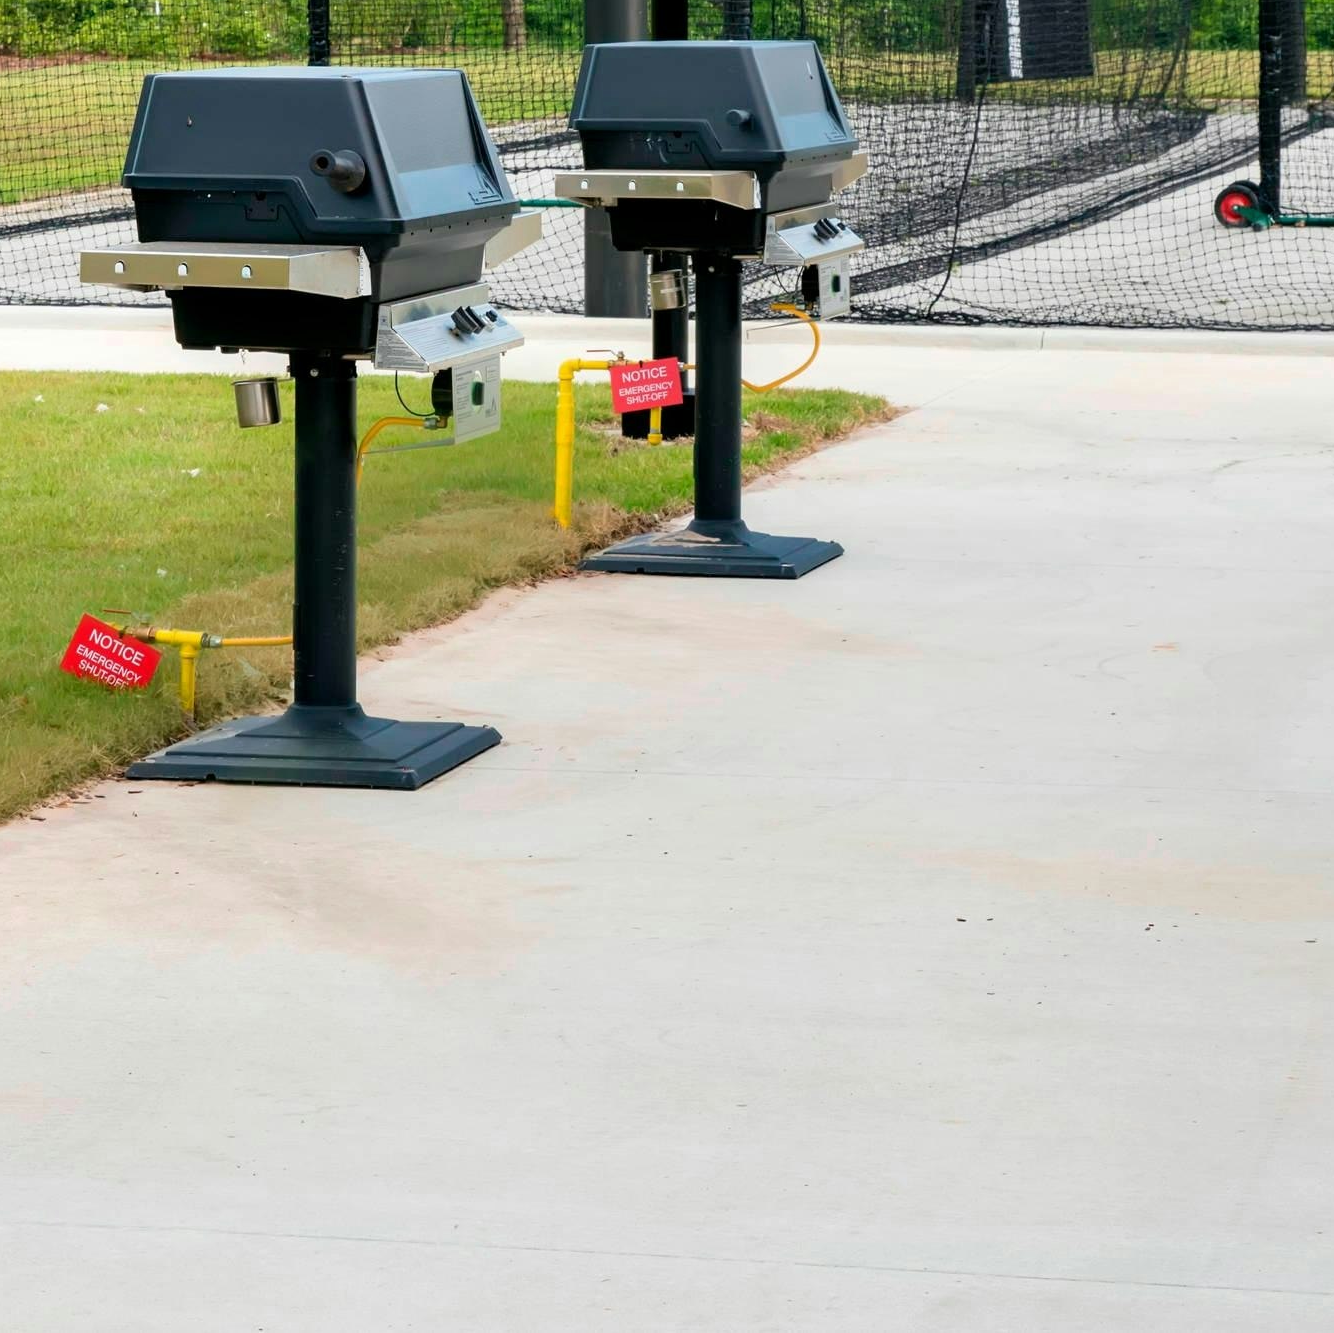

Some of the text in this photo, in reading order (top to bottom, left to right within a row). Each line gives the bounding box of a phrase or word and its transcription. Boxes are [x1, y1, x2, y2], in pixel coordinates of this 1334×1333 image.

[622, 366, 667, 383] NOTICE
[619, 381, 673, 397] EMERGENCY
[627, 391, 668, 405] SHUT-OFF
[89, 629, 145, 666] NOTICE
[76, 644, 142, 683] EMERGENCY
